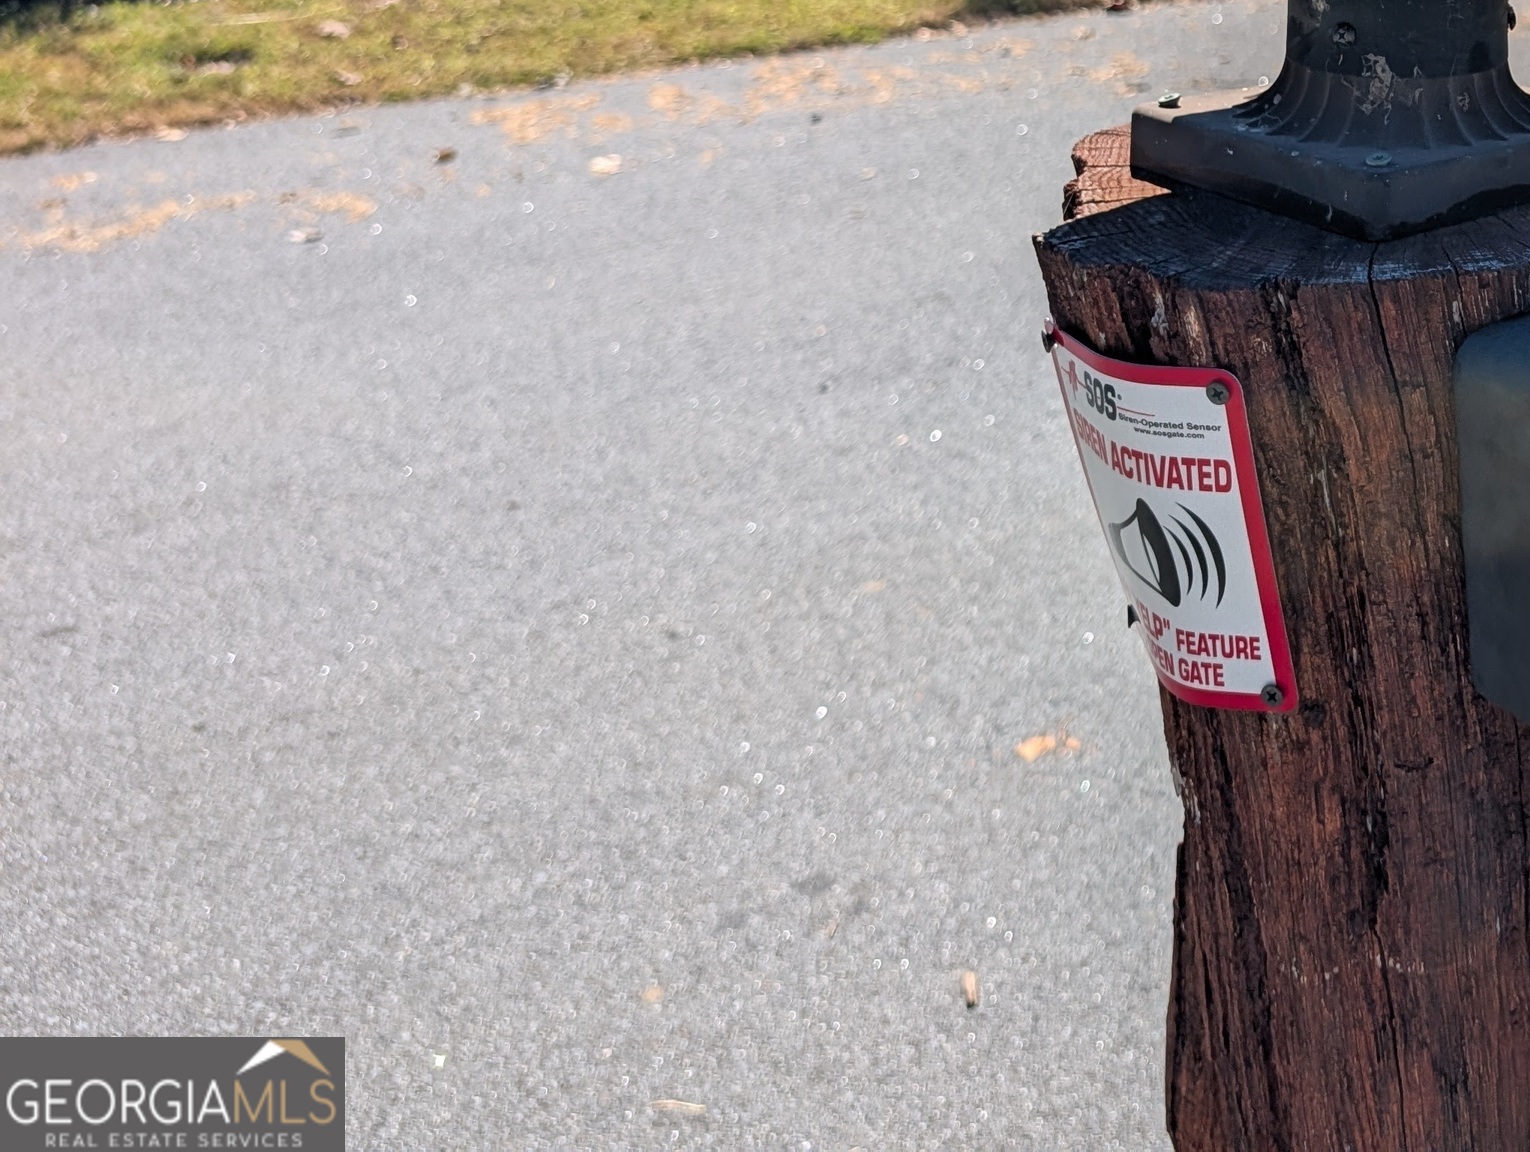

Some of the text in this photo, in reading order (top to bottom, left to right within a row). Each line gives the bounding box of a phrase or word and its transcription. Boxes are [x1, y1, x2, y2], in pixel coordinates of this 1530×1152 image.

[1084, 371, 1117, 421] SOS
[1118, 413, 1222, 432] Siren-Operated Sensor
[1133, 426, 1205, 439] www.sosgate.com
[1073, 407, 1232, 493] SIREN ACTIVATED
[1175, 628, 1262, 660] FEATURE
[1178, 657, 1225, 687] GATE
